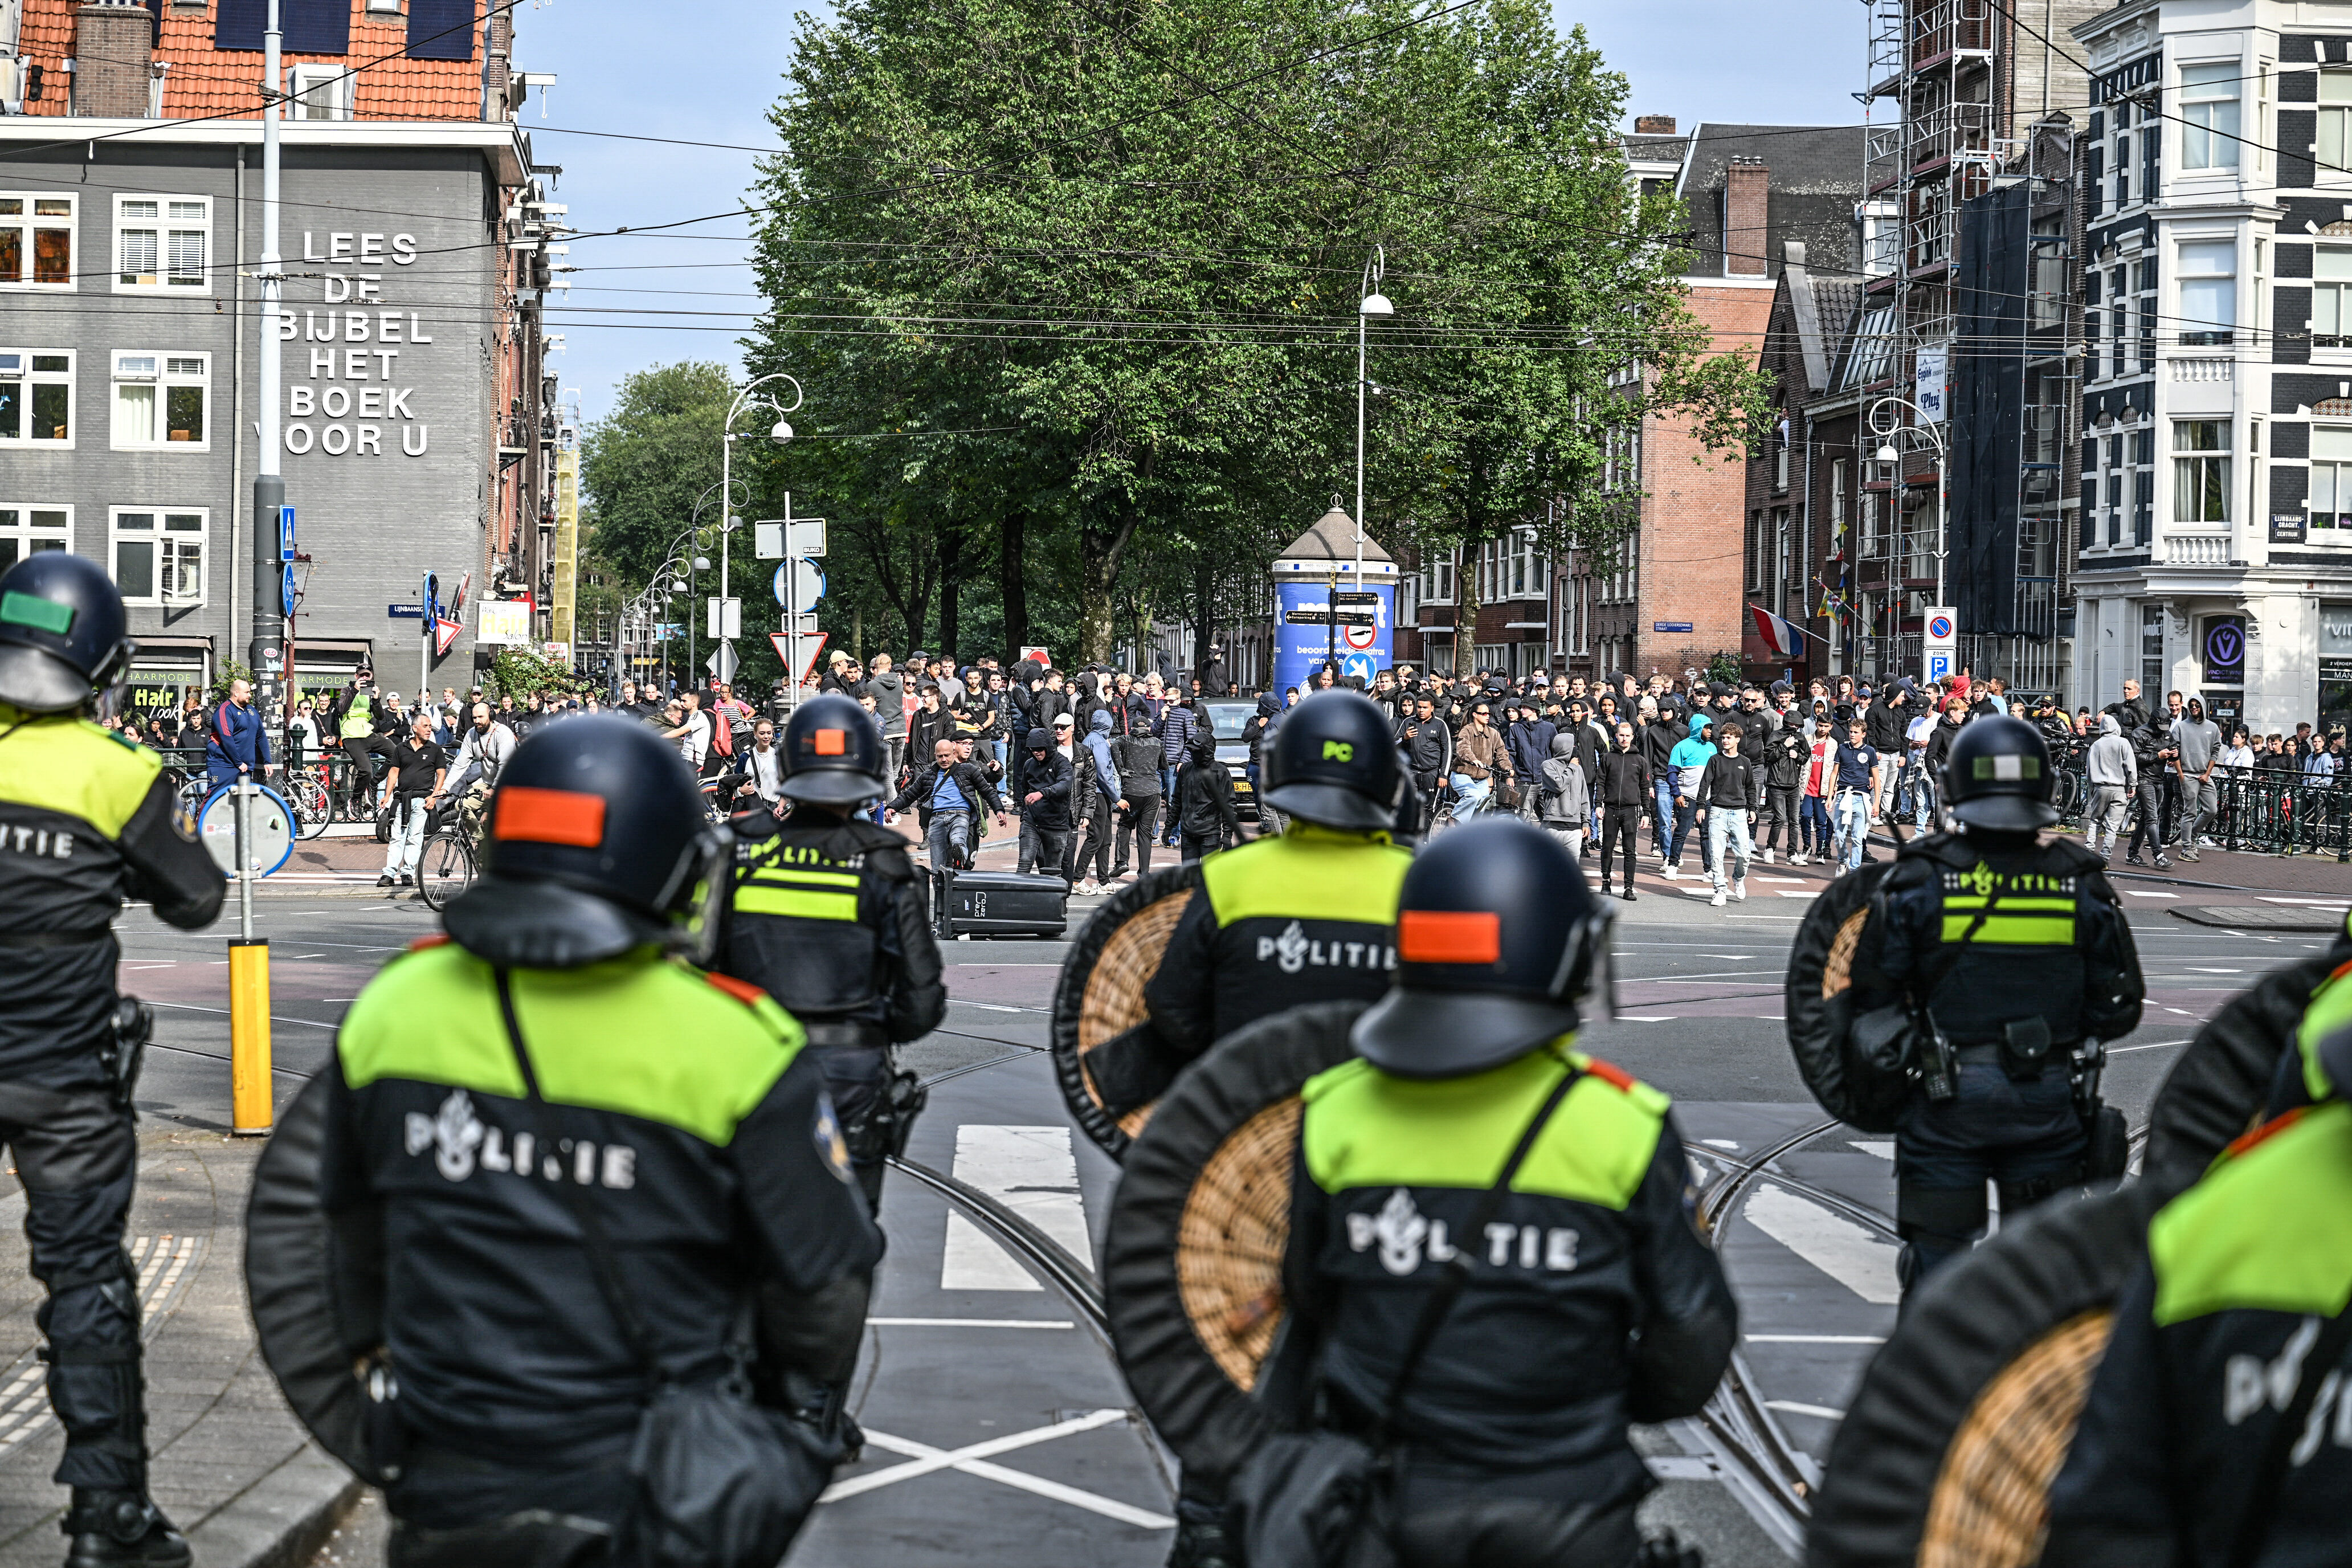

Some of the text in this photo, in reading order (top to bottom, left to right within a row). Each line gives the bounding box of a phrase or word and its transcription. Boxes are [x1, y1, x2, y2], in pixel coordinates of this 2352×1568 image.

[304, 232, 416, 264] LEES
[325, 273, 381, 304] DE
[280, 310, 432, 344] BIJBEL
[310, 348, 398, 380] HET
[1918, 366, 1932, 382] Eggink
[290, 386, 414, 419] BOEK
[1921, 391, 1940, 411] Plug
[254, 422, 427, 456] OOR U
[481, 614, 528, 634] Hair
[503, 630, 528, 640] Salon
[1934, 659, 1945, 672] P
[126, 673, 191, 682] HAARMODE
[134, 688, 174, 707] Hair
[1322, 740, 1354, 762] PC
[1345, 1186, 1580, 1276] POLTIE
